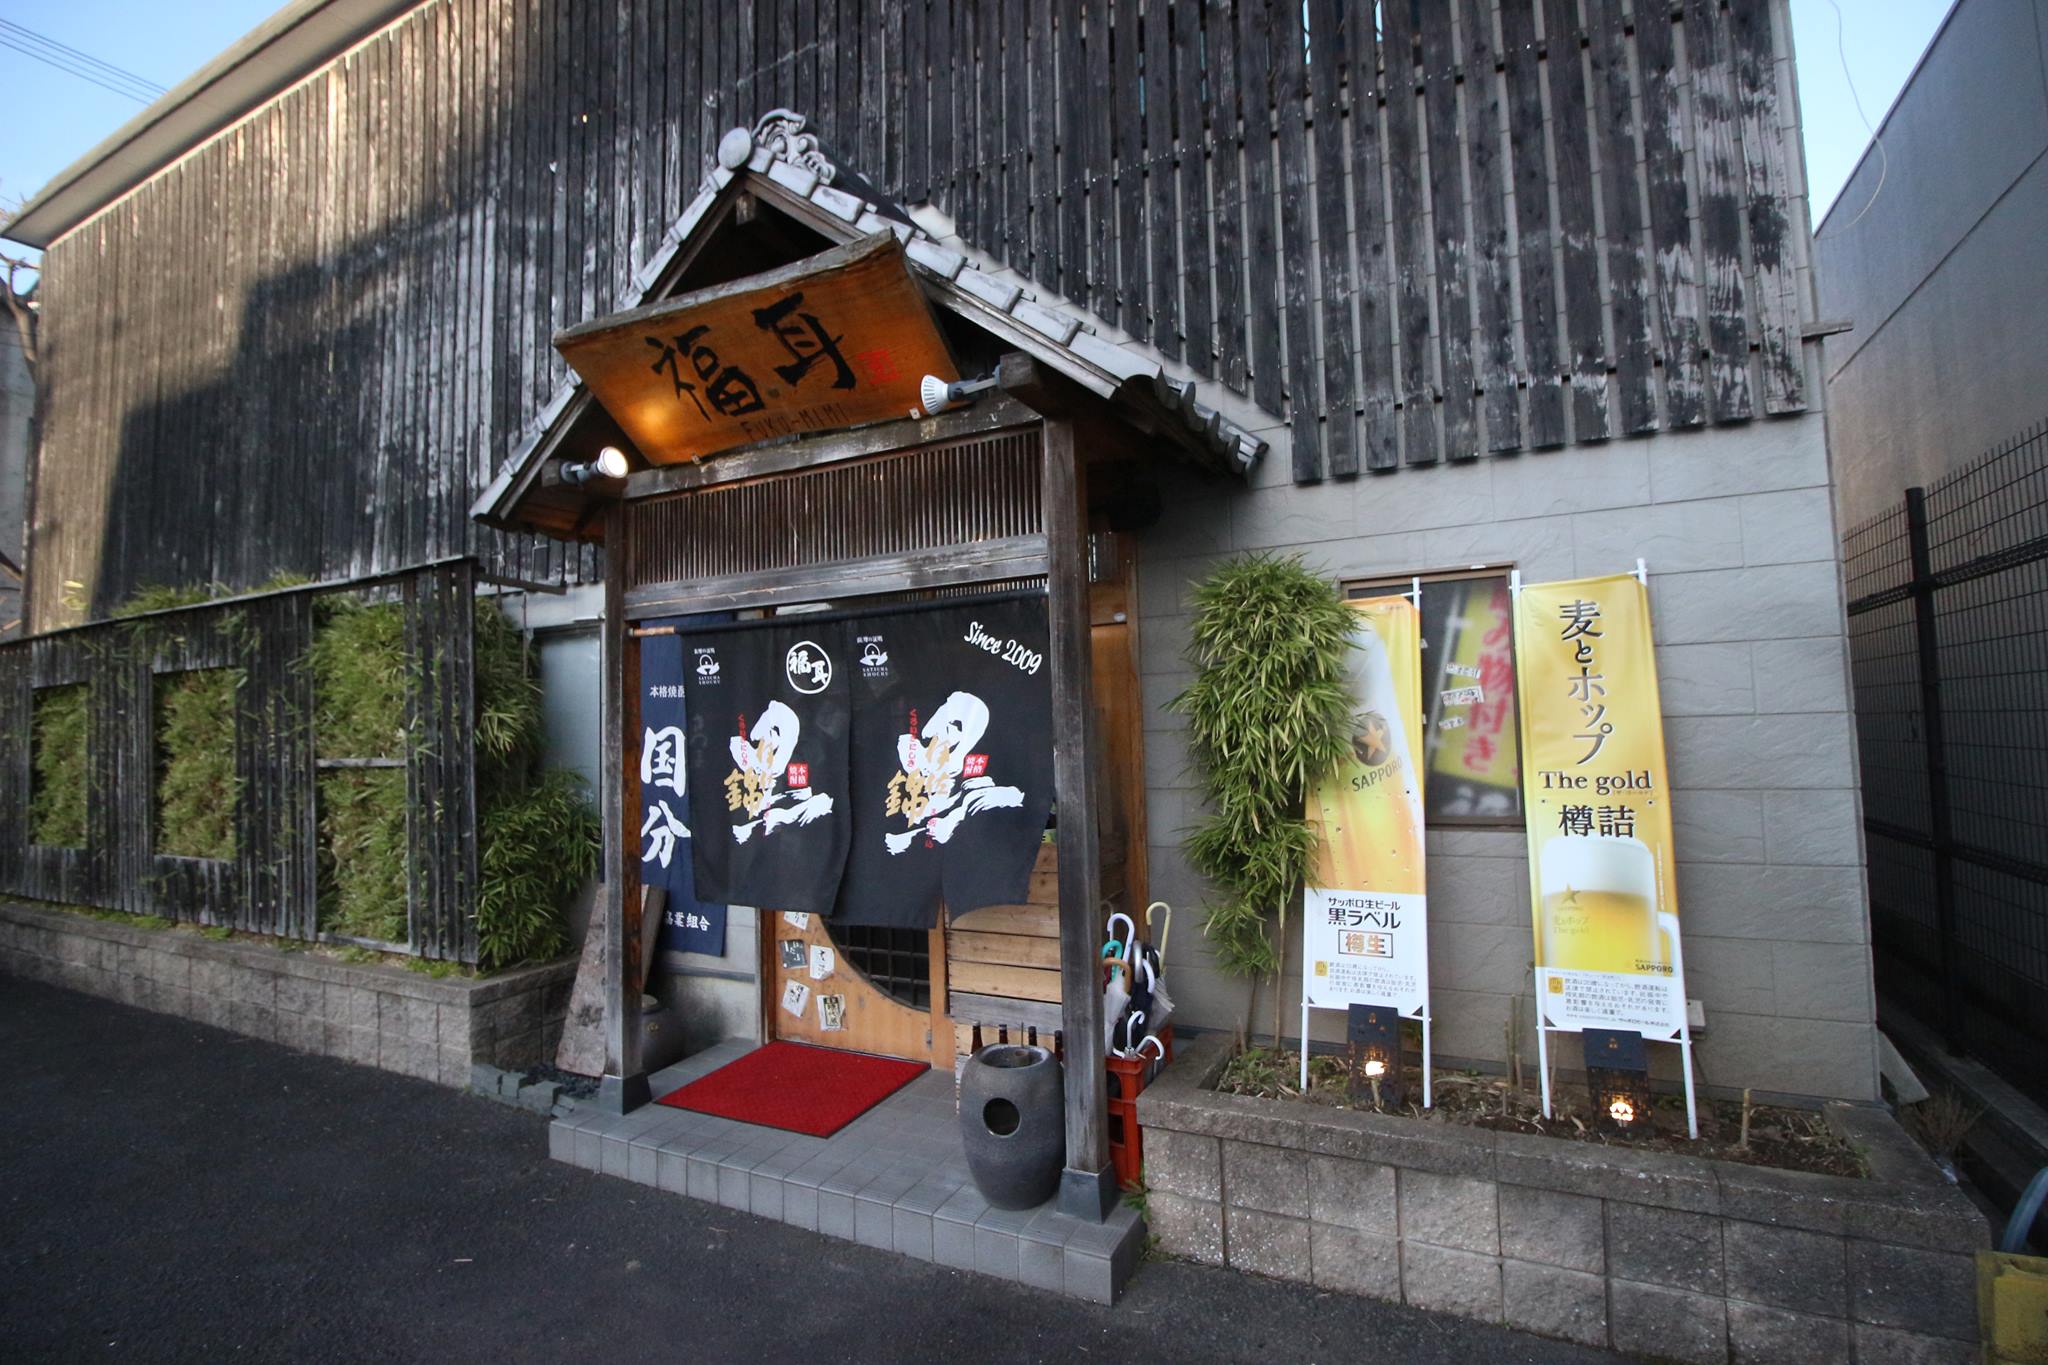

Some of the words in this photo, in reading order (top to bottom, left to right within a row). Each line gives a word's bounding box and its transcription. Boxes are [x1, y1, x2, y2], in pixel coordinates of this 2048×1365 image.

[645, 291, 857, 423] 福耳
[740, 402, 850, 441] FUKU-MIMI
[963, 620, 1002, 655] Since
[1001, 639, 1042, 675] 2009
[788, 649, 829, 685] 福耳
[1559, 599, 1613, 765] 麦とホップ
[1351, 756, 1402, 793] SAPPORO
[1538, 770, 1589, 790] The
[1595, 769, 1653, 796] gold
[640, 726, 692, 868] 国分
[1558, 804, 1636, 838] 樽詰
[1328, 897, 1401, 911] サッポロ生ビール
[1328, 907, 1402, 929] 黒ラベル
[1345, 932, 1386, 955] 樽生
[1634, 963, 1674, 974] SAPPORO
